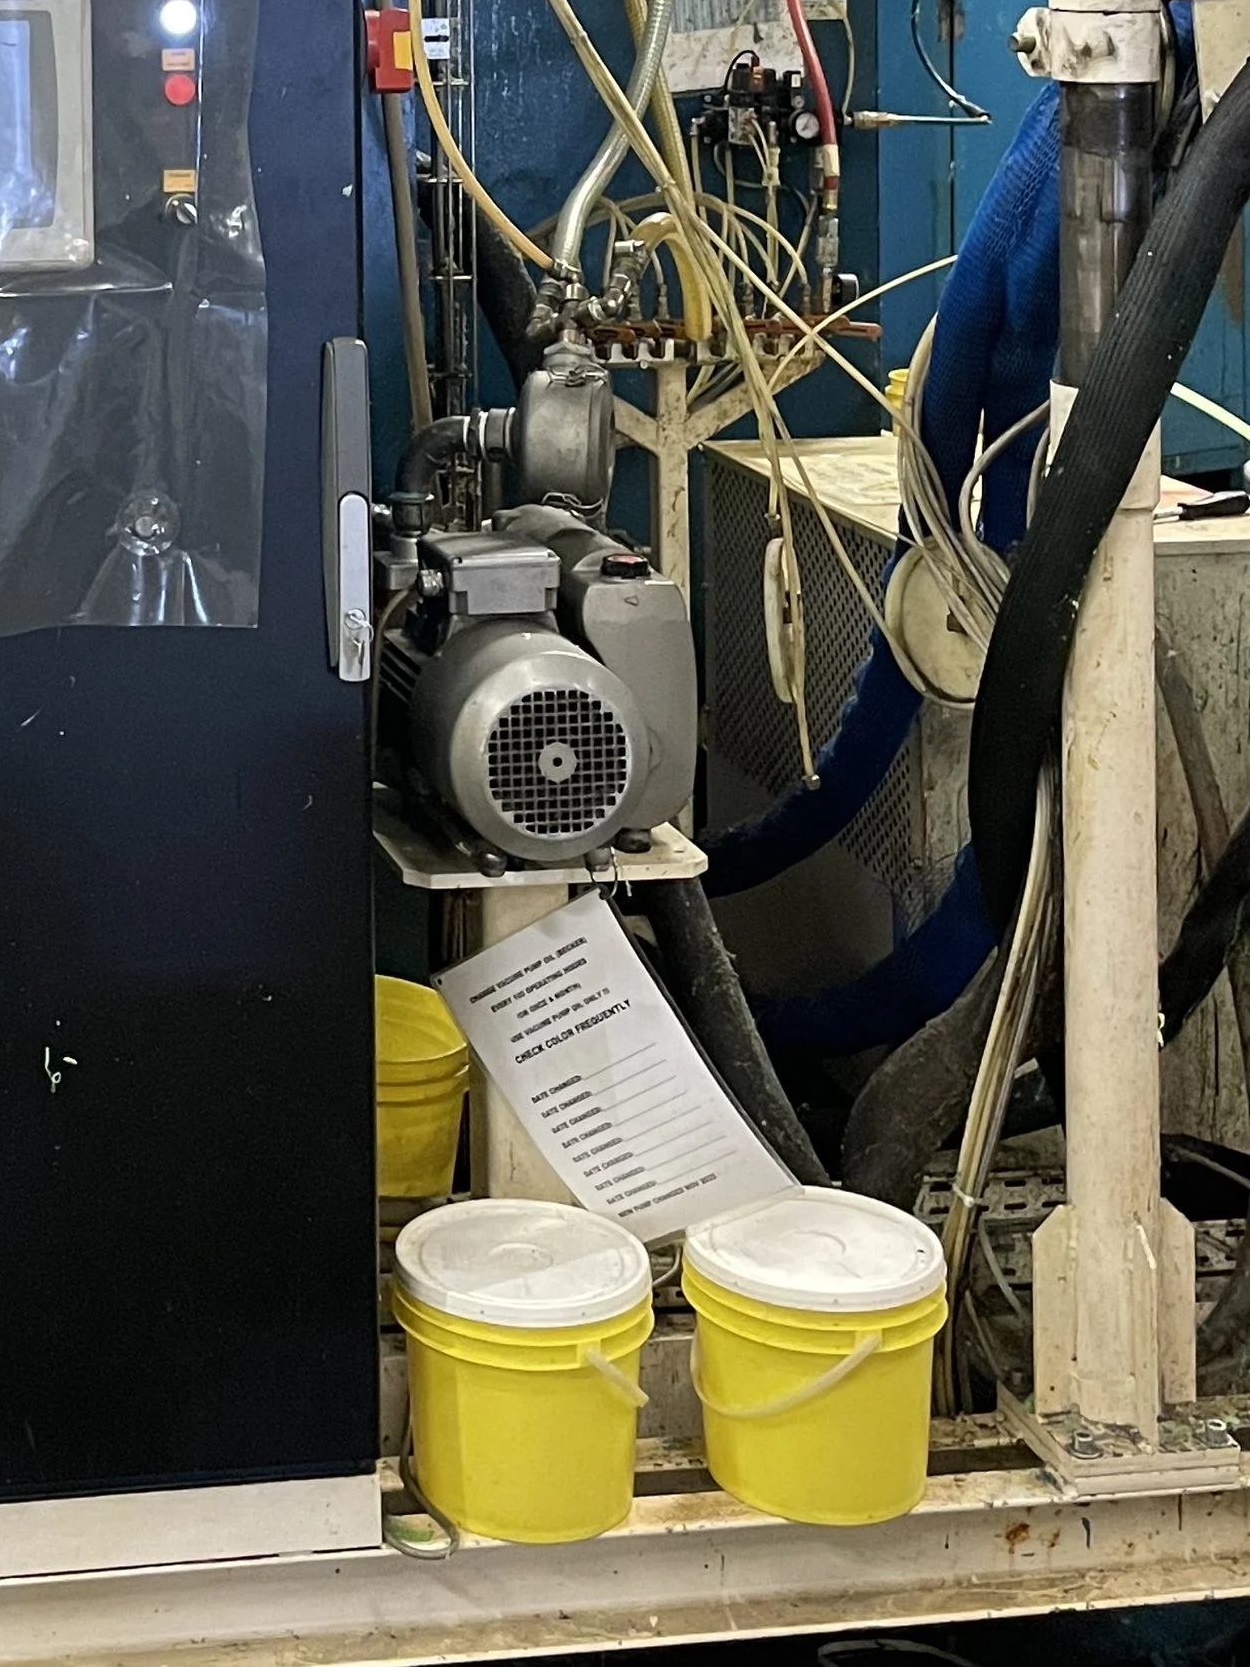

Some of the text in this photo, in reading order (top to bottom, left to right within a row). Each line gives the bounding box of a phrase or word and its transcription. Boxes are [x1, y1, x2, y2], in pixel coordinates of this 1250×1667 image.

[525, 971, 563, 994] OPERATING
[514, 999, 631, 1064] CHECK COLOR FREQUENTLY
